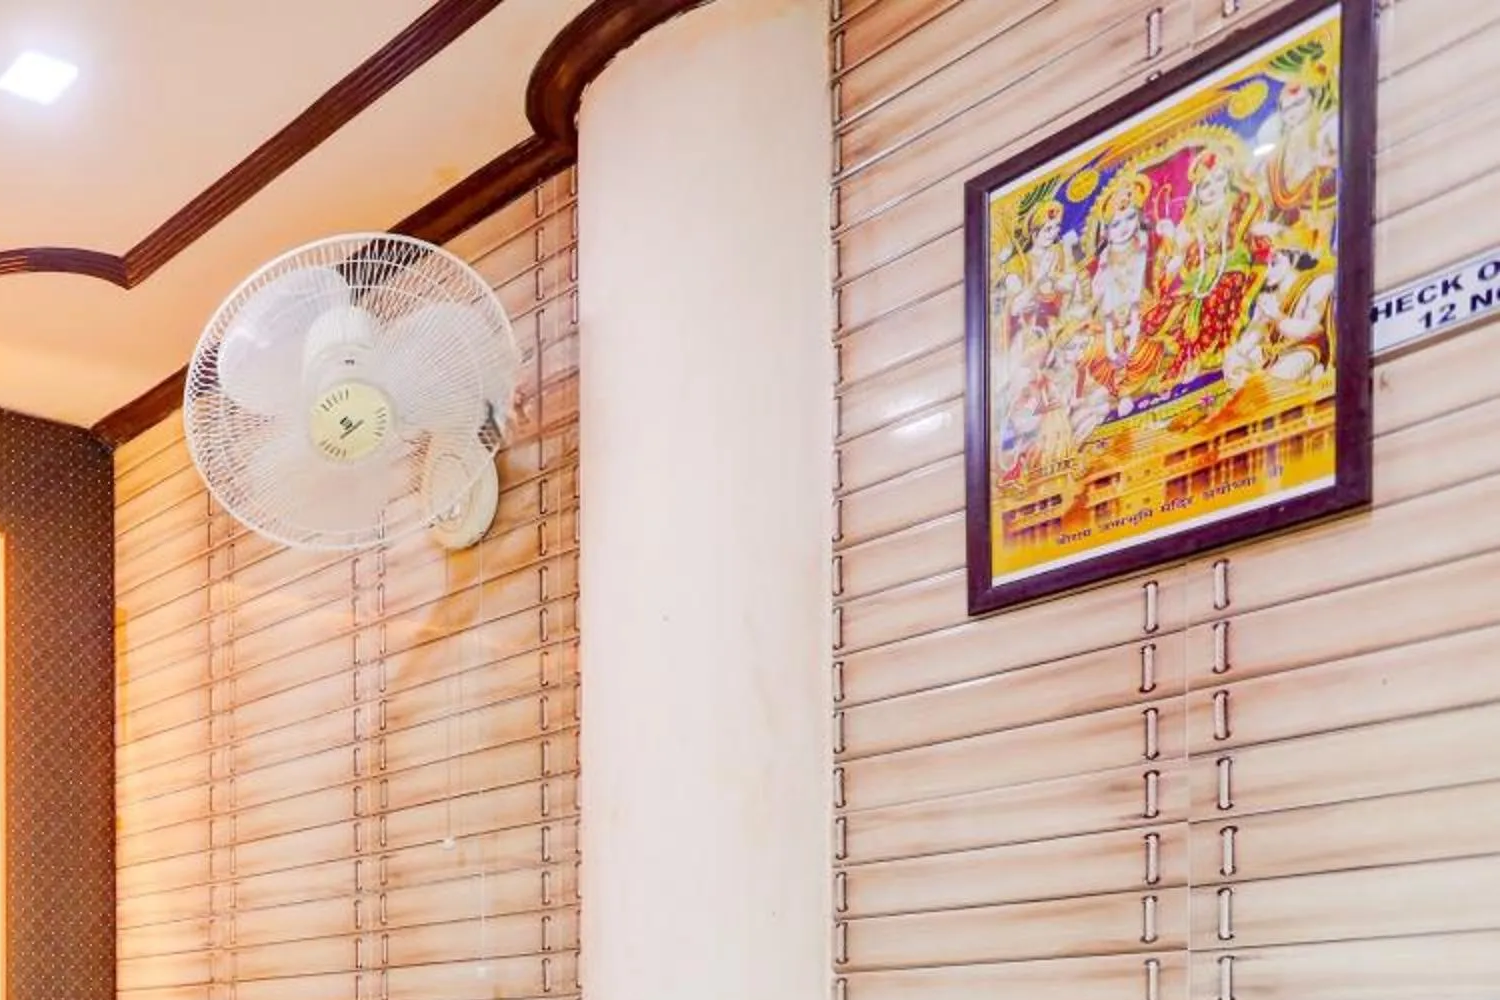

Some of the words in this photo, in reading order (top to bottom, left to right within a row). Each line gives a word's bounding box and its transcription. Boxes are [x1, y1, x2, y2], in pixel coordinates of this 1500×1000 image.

[1369, 273, 1463, 325] HECK
[1418, 302, 1457, 329] 12
[1470, 287, 1500, 313] N
